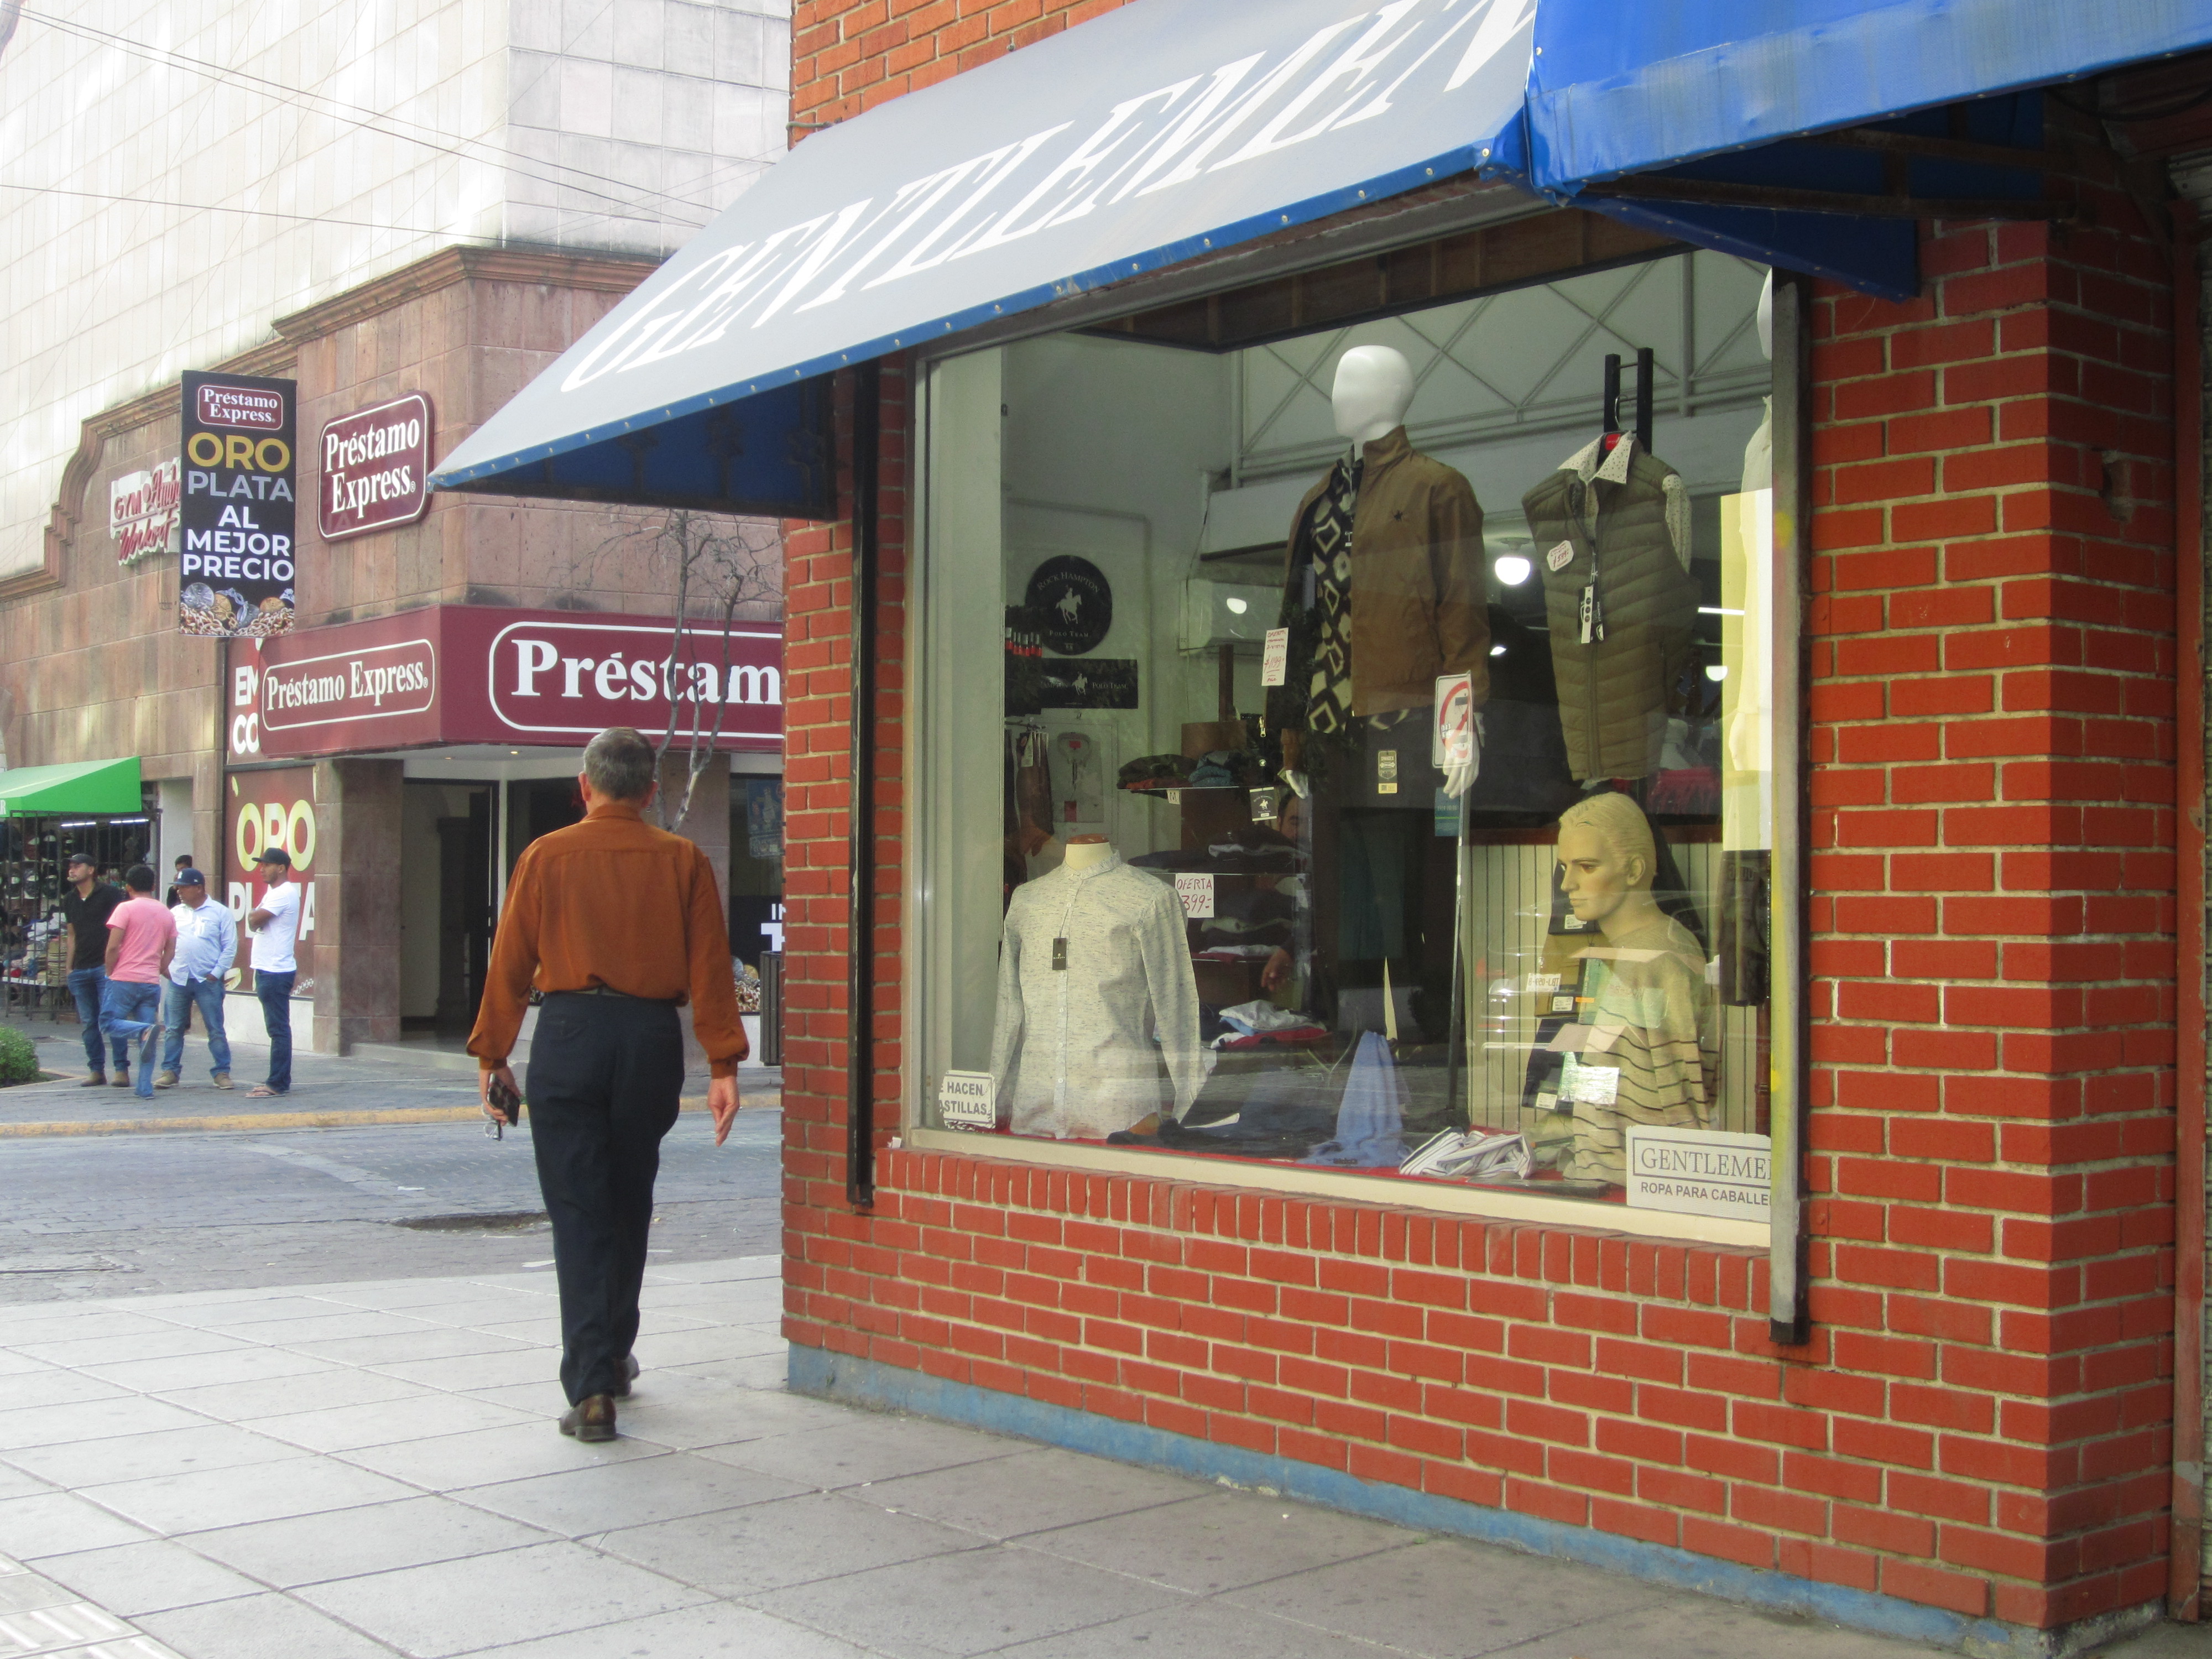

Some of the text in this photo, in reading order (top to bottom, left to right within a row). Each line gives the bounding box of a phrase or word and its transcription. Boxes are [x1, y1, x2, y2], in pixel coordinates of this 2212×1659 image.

[203, 388, 278, 409] Préstamo
[187, 432, 290, 472] ORO
[325, 419, 420, 472] Préstamo
[188, 470, 294, 503] PLATA
[217, 505, 259, 529] AL
[187, 528, 290, 556] MEJOR
[183, 554, 294, 581] PRECIO
[1037, 571, 1100, 592] ROCK HAMPTON
[267, 672, 344, 711] Préstamo
[1177, 878, 1212, 890] OFERTA
[947, 1082, 983, 1096] HACEN
[1641, 1147, 1771, 1180] GENTLEME
[1641, 1182, 1771, 1207] ROPA PARA CABALLE
